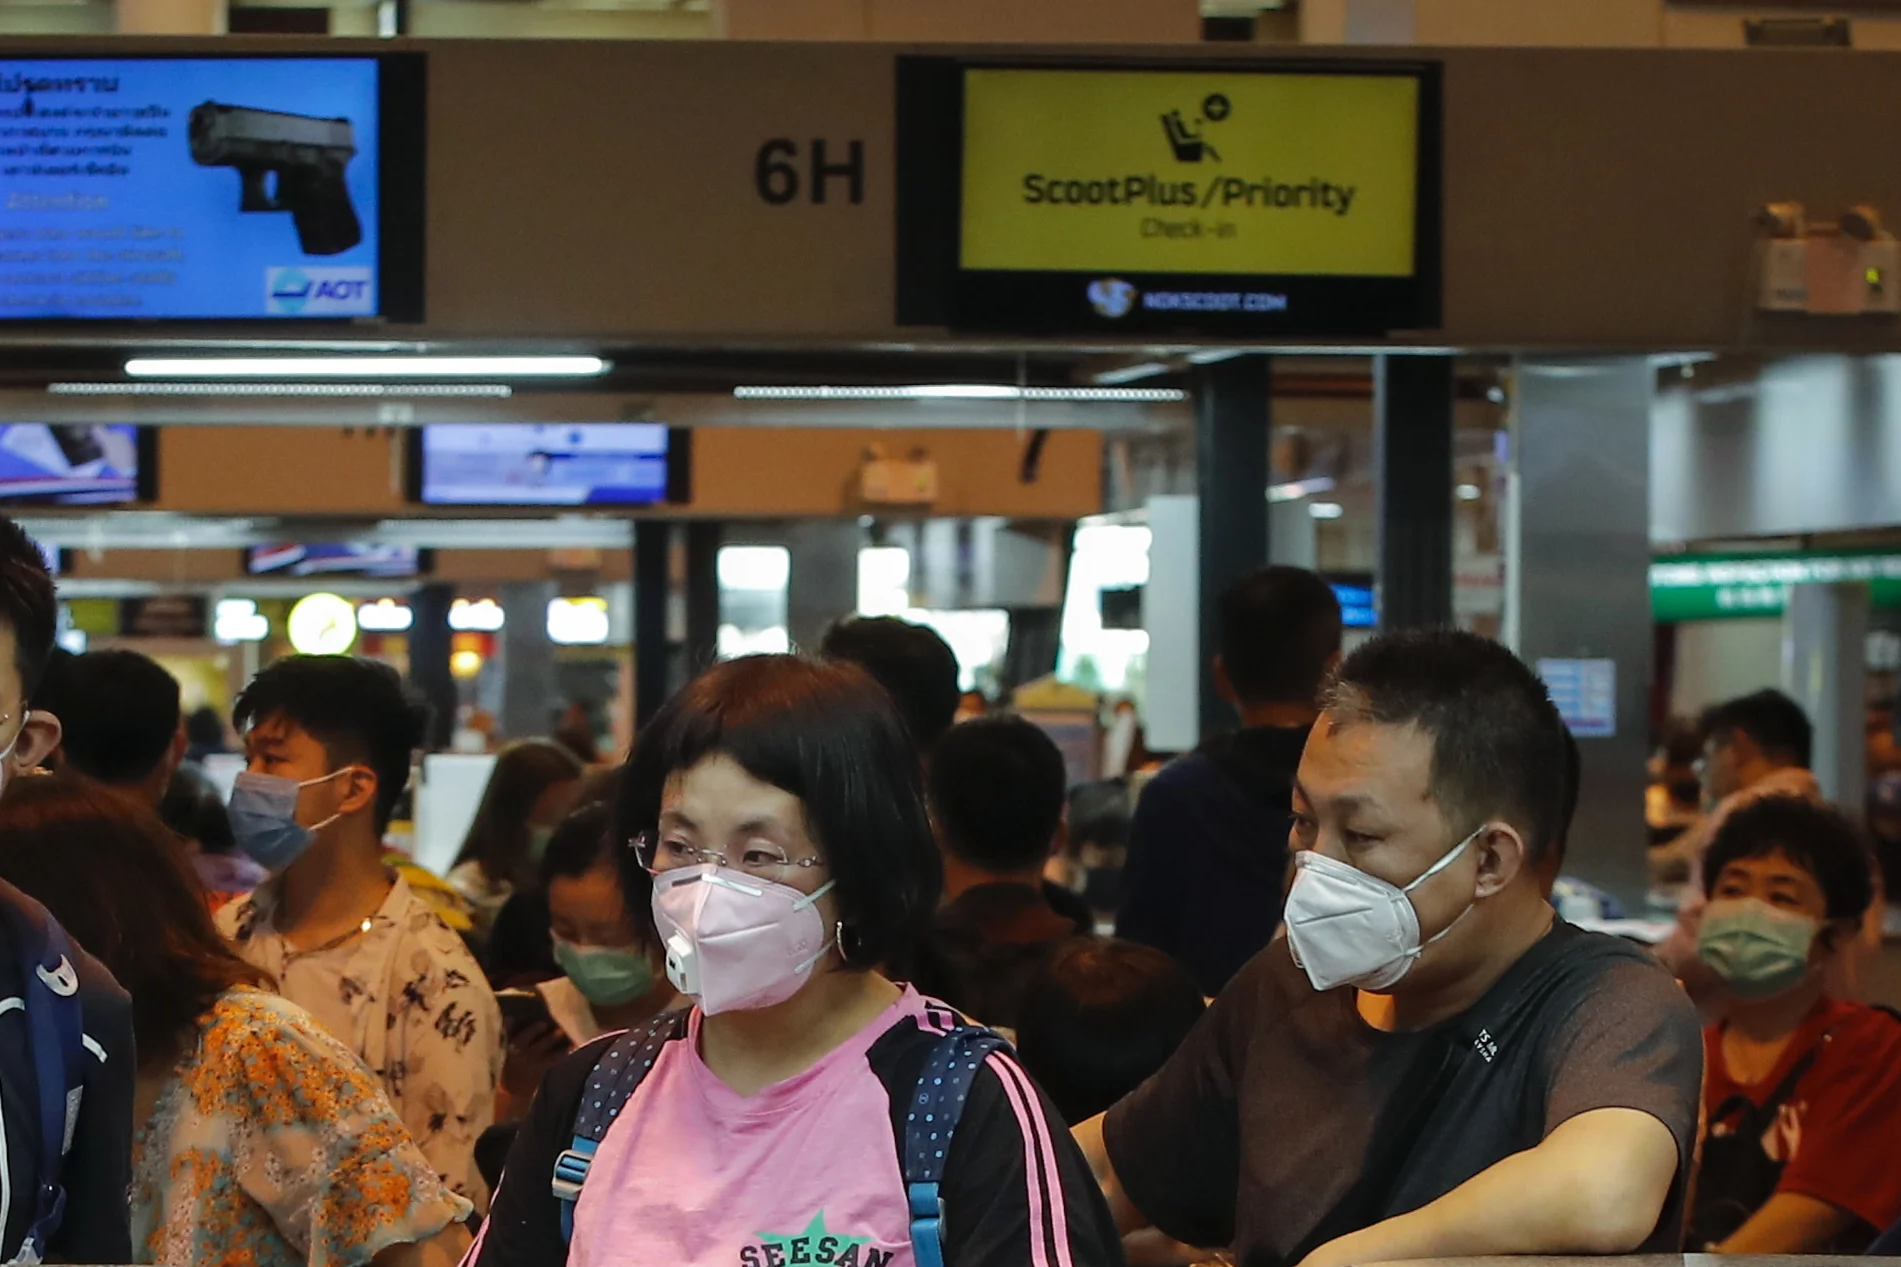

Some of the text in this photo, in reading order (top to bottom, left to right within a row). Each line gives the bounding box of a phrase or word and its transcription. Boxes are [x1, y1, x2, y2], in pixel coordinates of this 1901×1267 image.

[755, 138, 865, 206] 6H
[1140, 217, 1238, 239] Check-in
[315, 280, 368, 300] AOT
